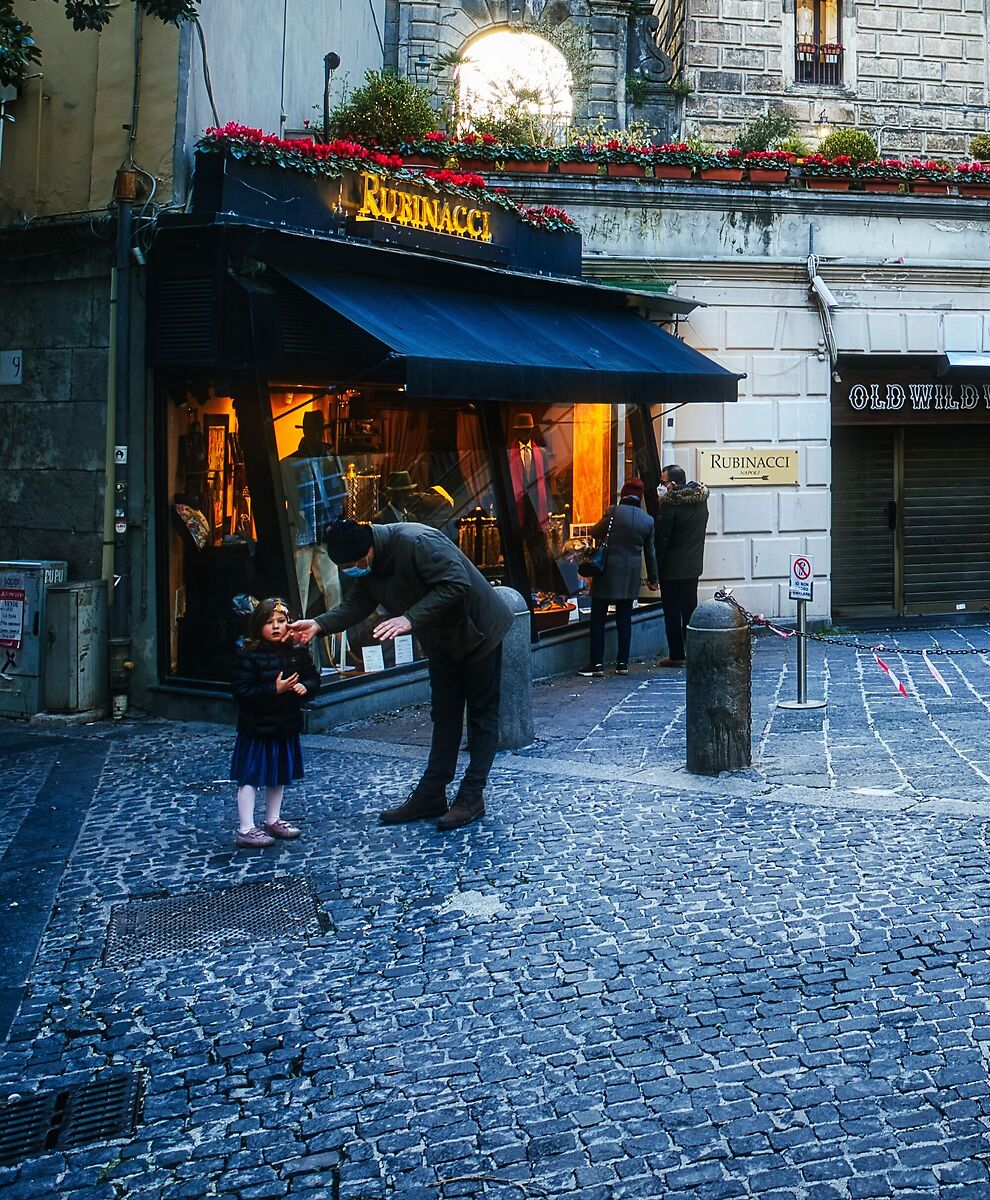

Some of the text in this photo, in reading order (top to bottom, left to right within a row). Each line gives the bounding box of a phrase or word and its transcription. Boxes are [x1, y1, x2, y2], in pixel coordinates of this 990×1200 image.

[358, 171, 491, 242] RUBINACCI
[849, 383, 906, 411] OLD
[908, 383, 980, 411] WILD
[710, 453, 790, 469] RUBINACCI
